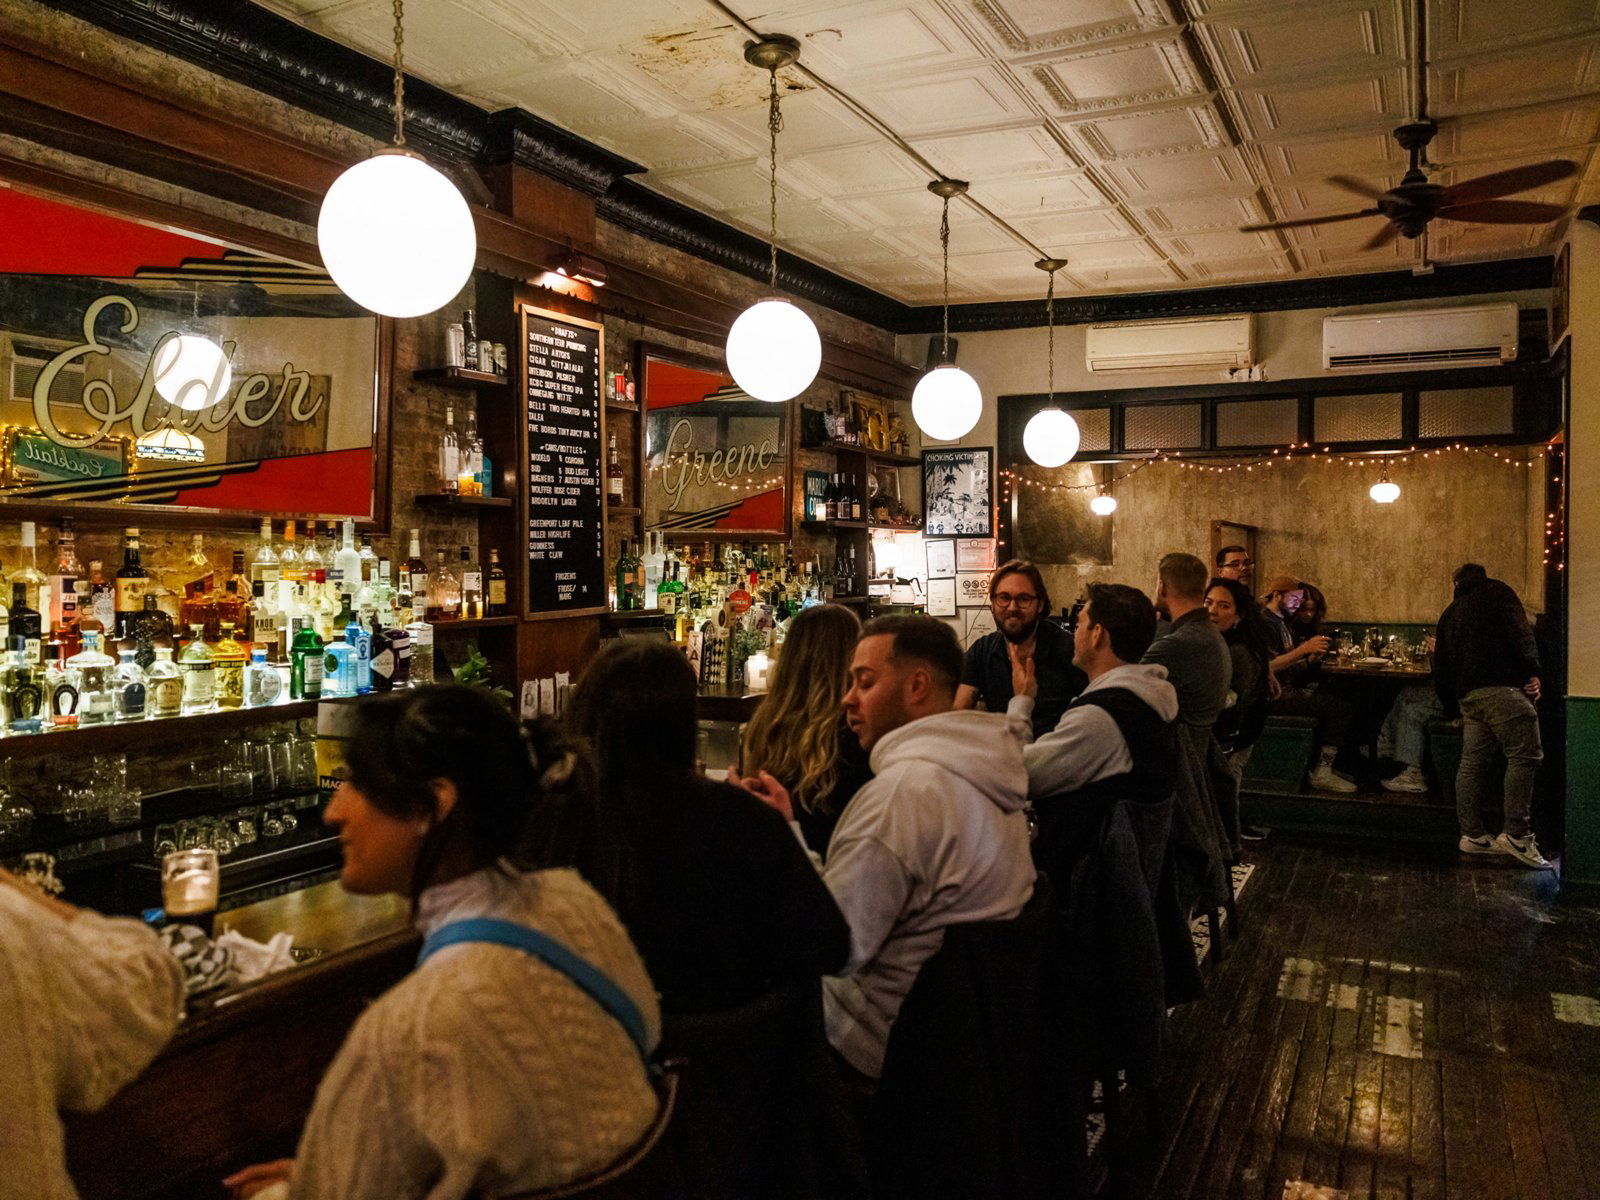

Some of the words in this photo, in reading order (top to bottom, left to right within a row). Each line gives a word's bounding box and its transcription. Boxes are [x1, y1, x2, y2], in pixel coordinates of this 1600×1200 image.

[554, 327, 575, 339] DRAFTS
[529, 344, 548, 355] STELLA
[551, 349, 570, 359] ARTOIS
[529, 355, 546, 365] CIGAR
[551, 360, 563, 369] CITY
[32, 294, 324, 449] Elder
[545, 381, 560, 390] SUPER
[561, 384, 574, 393] HERO
[556, 392, 572, 402] WITTE
[529, 401, 545, 410] BELLS
[549, 404, 560, 412] TWO
[582, 409, 590, 417] IPA
[528, 412, 544, 421] TALEA
[529, 424, 538, 432] FIVE
[544, 444, 582, 455] CANS/BOTTLES
[531, 453, 550, 462] MODELO
[565, 456, 584, 464] CORONA
[954, 453, 974, 461] VICTIM
[662, 418, 774, 512] Greene
[532, 497, 557, 505] BROOKLYN
[255, 618, 274, 629] KNOB
